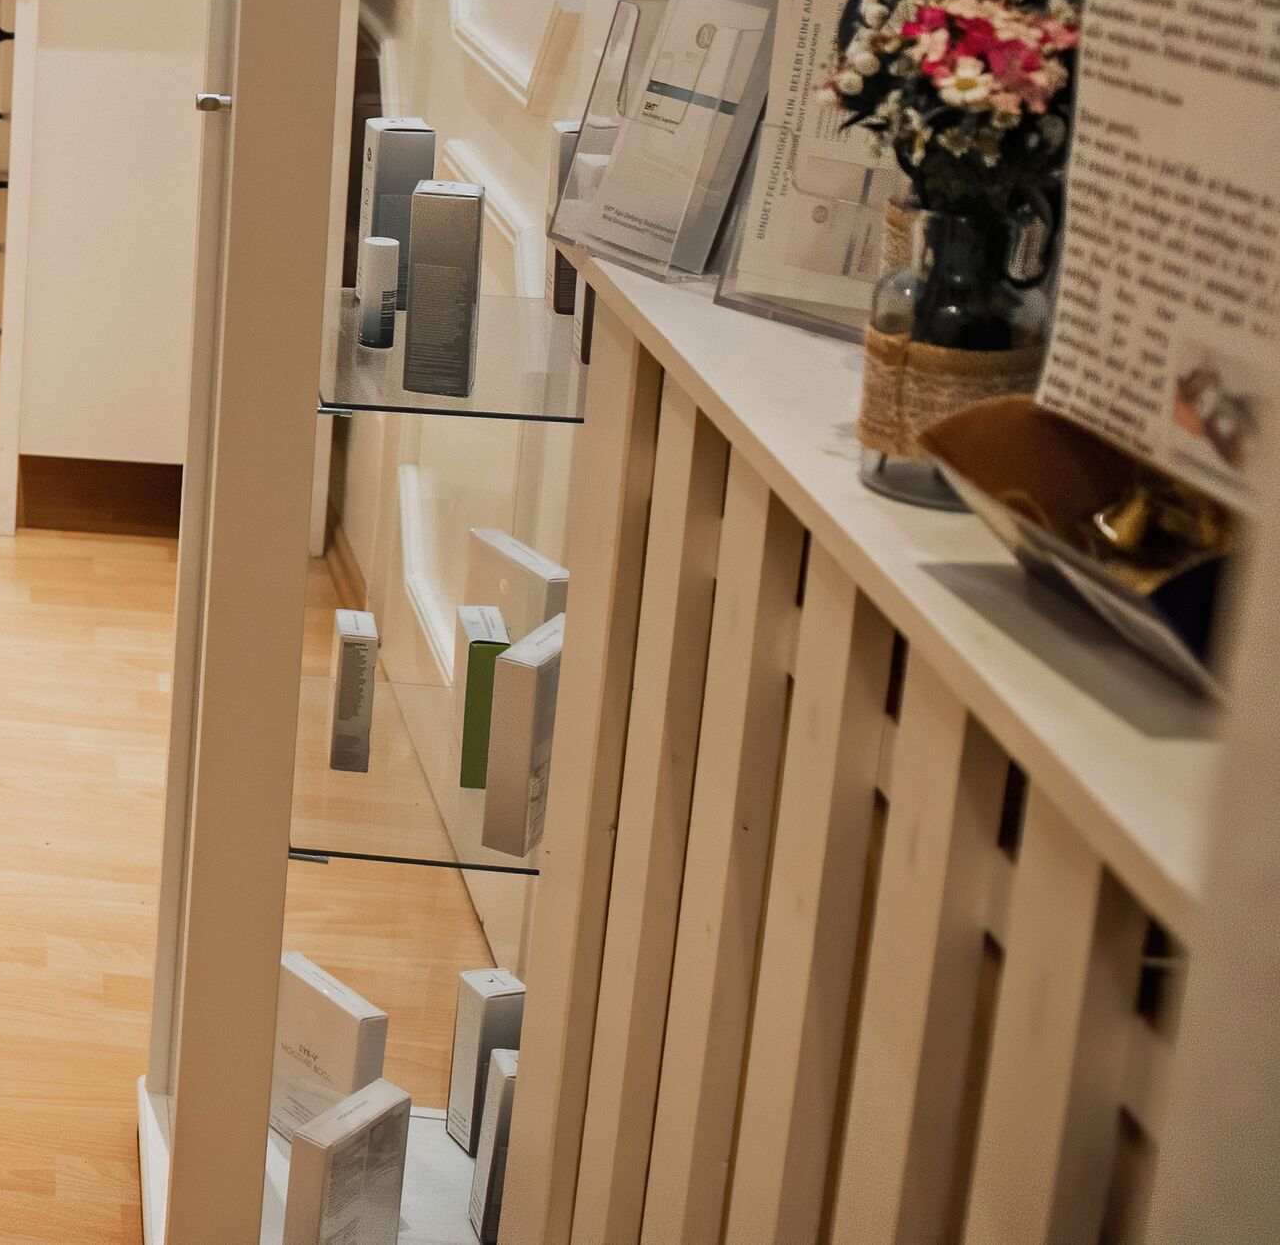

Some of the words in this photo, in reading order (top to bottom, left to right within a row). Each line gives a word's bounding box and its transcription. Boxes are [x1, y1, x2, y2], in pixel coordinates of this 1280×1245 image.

[757, 200, 772, 240] BINDET
[767, 125, 789, 198] FEUCHTIGKEIT
[791, 53, 805, 93] BELEBT
[799, 15, 810, 50] DEINE
